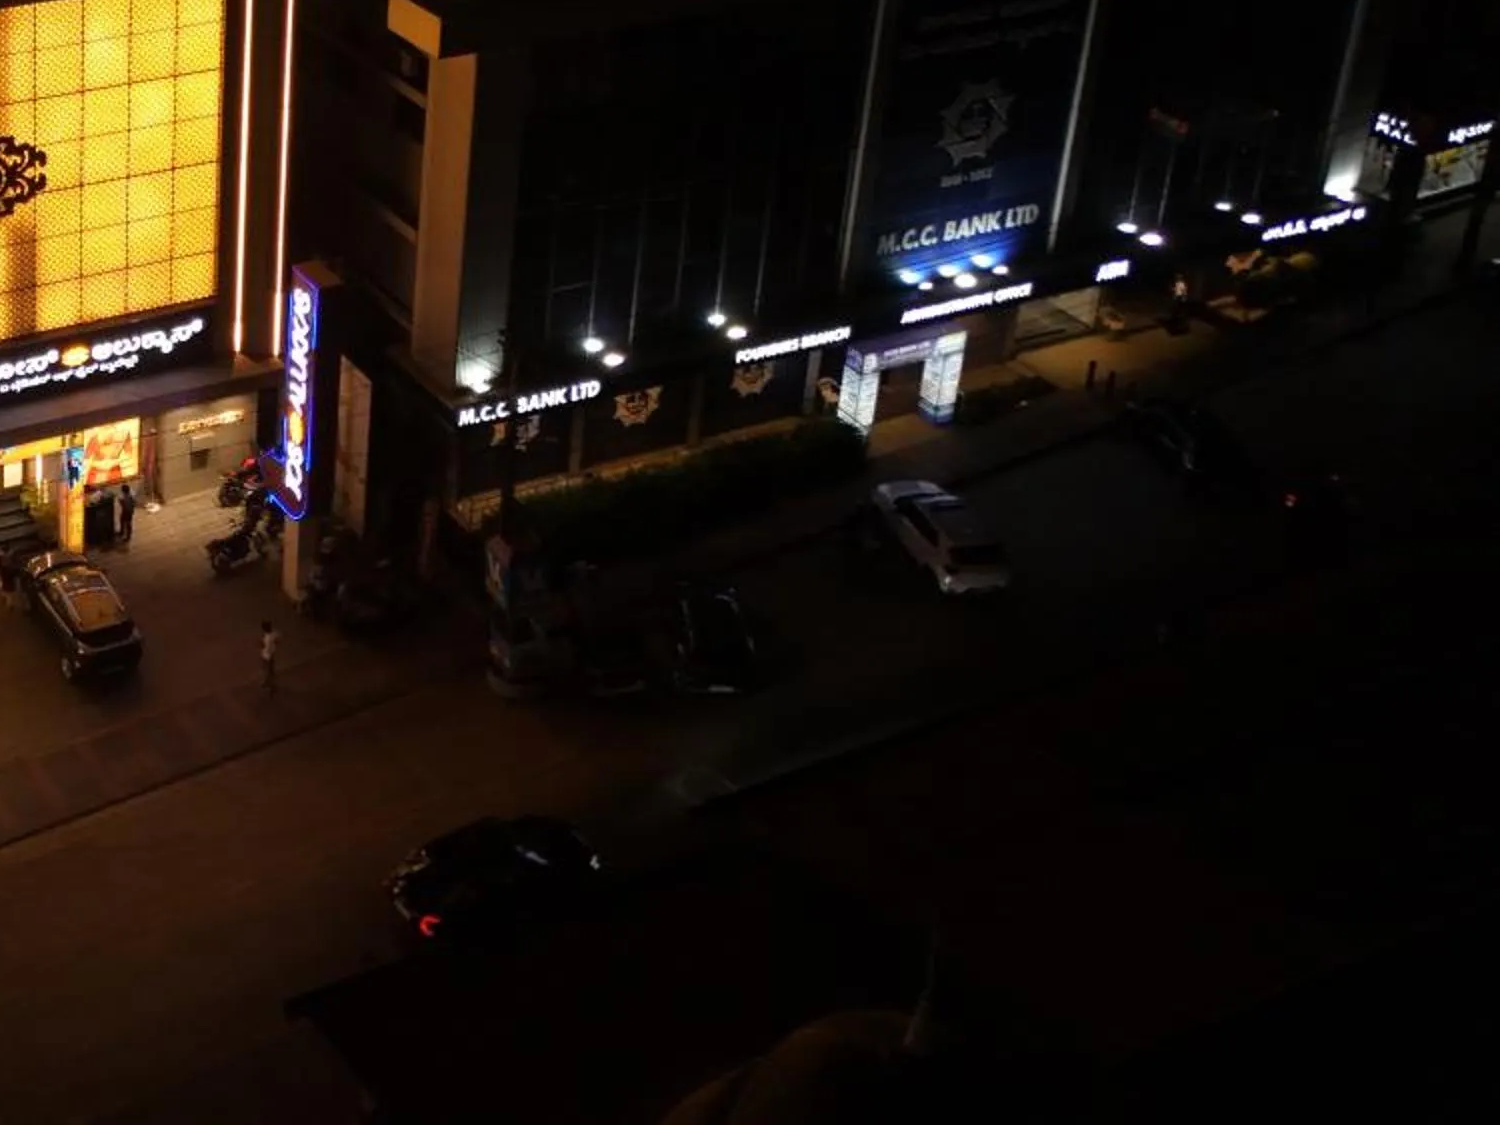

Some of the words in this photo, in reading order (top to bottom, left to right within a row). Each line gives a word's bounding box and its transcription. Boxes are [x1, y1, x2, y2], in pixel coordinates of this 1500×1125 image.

[943, 211, 1003, 242] BANK
[1005, 204, 1040, 228] LTD
[516, 387, 568, 414] BANK
[570, 380, 601, 403] LTD
[285, 443, 303, 501] JOS
